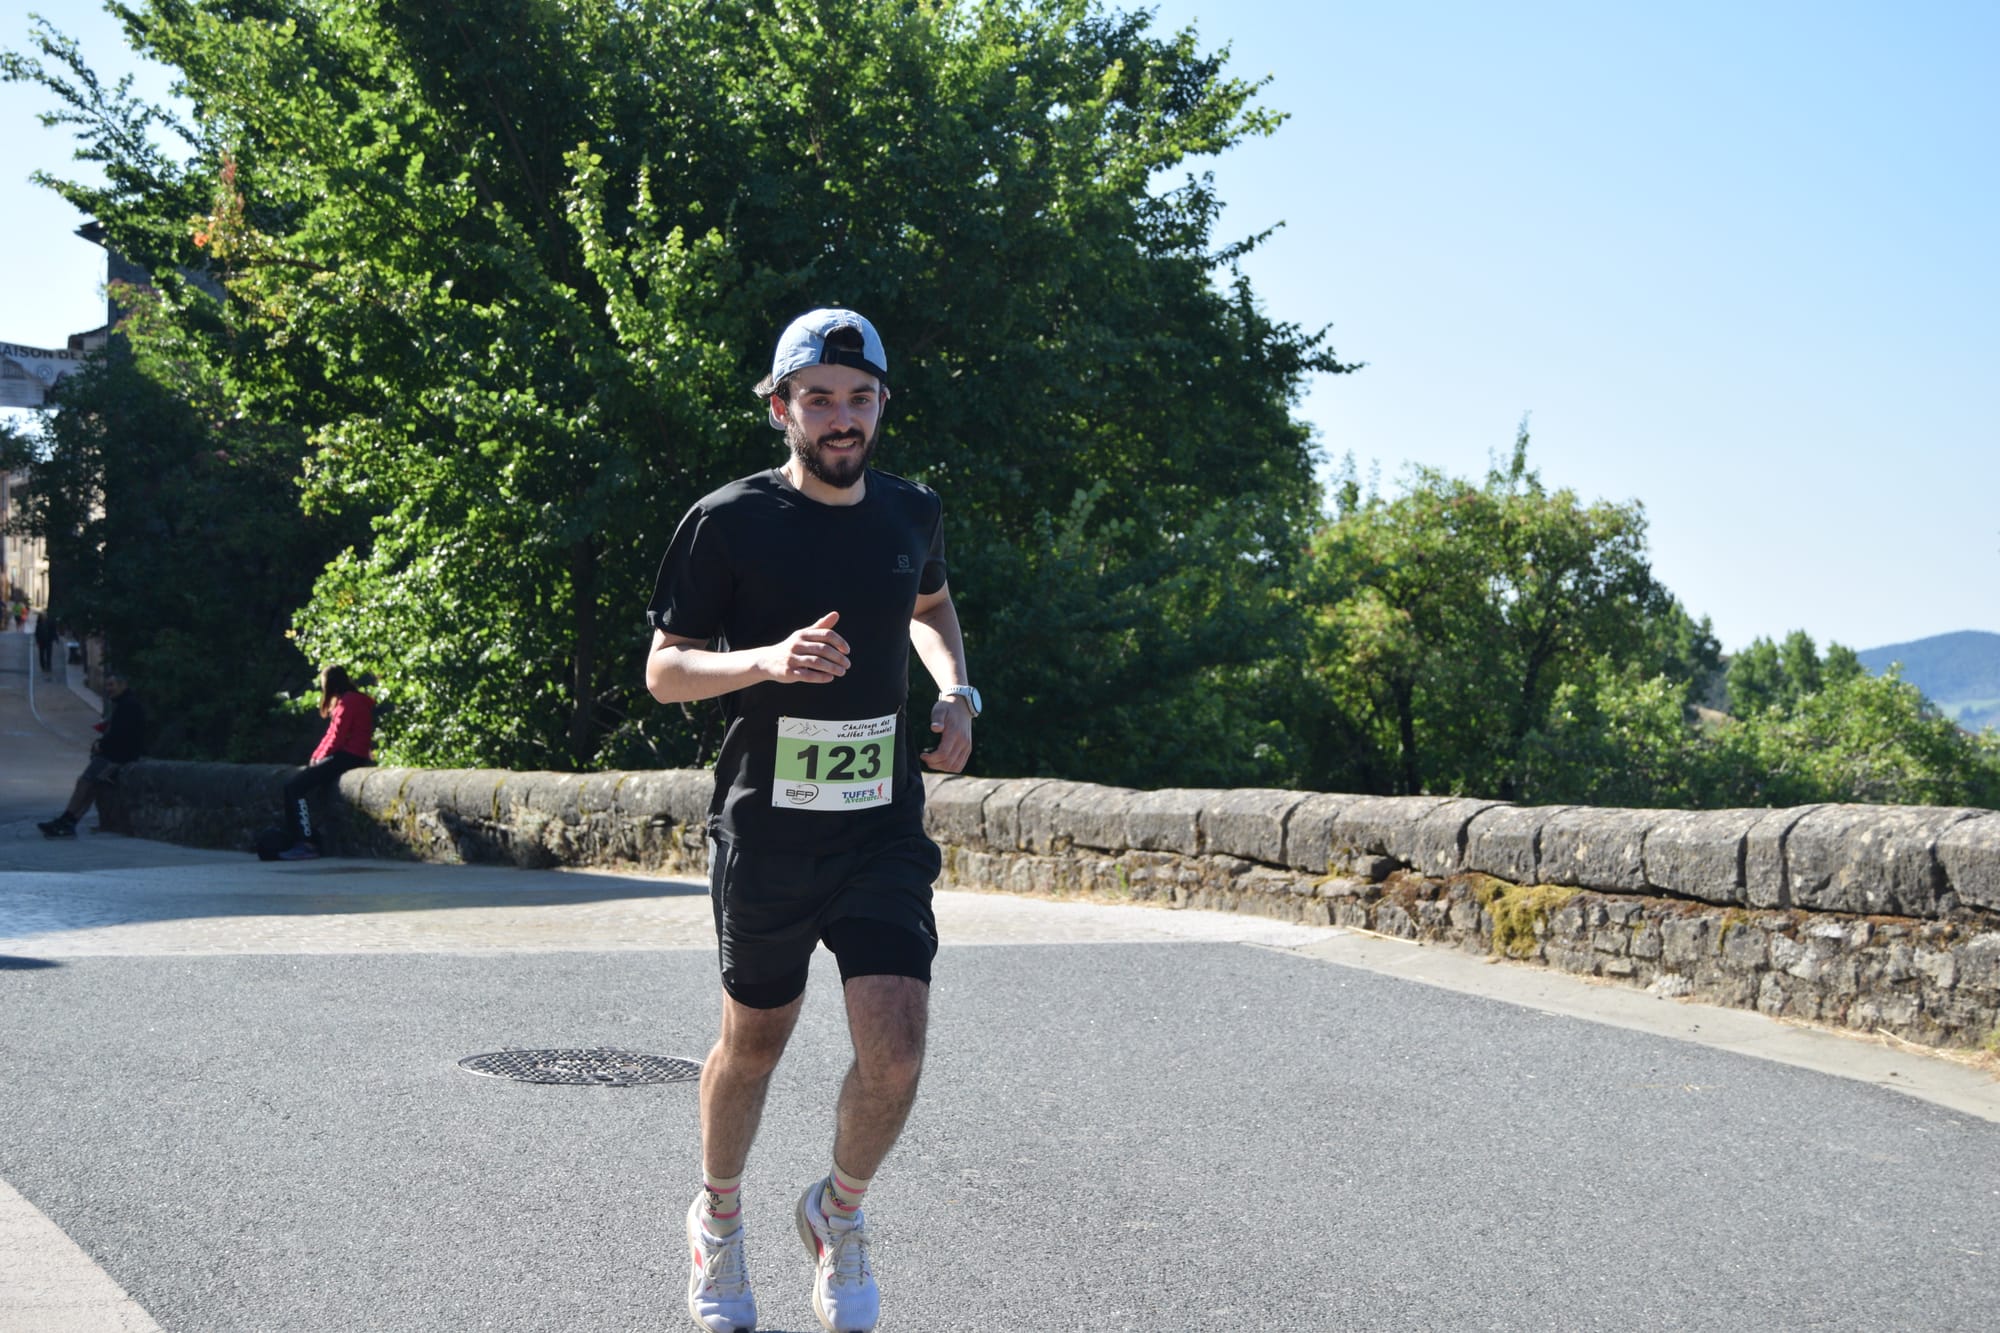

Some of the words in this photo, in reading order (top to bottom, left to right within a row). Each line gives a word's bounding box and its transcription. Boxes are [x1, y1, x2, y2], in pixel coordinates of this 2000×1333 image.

[0, 345, 53, 359] AISON
[842, 723, 877, 731] Challenge
[837, 730, 864, 738] vallées
[797, 743, 881, 781] 123
[786, 788, 814, 798] BFP
[841, 789, 875, 799] TUFF'S
